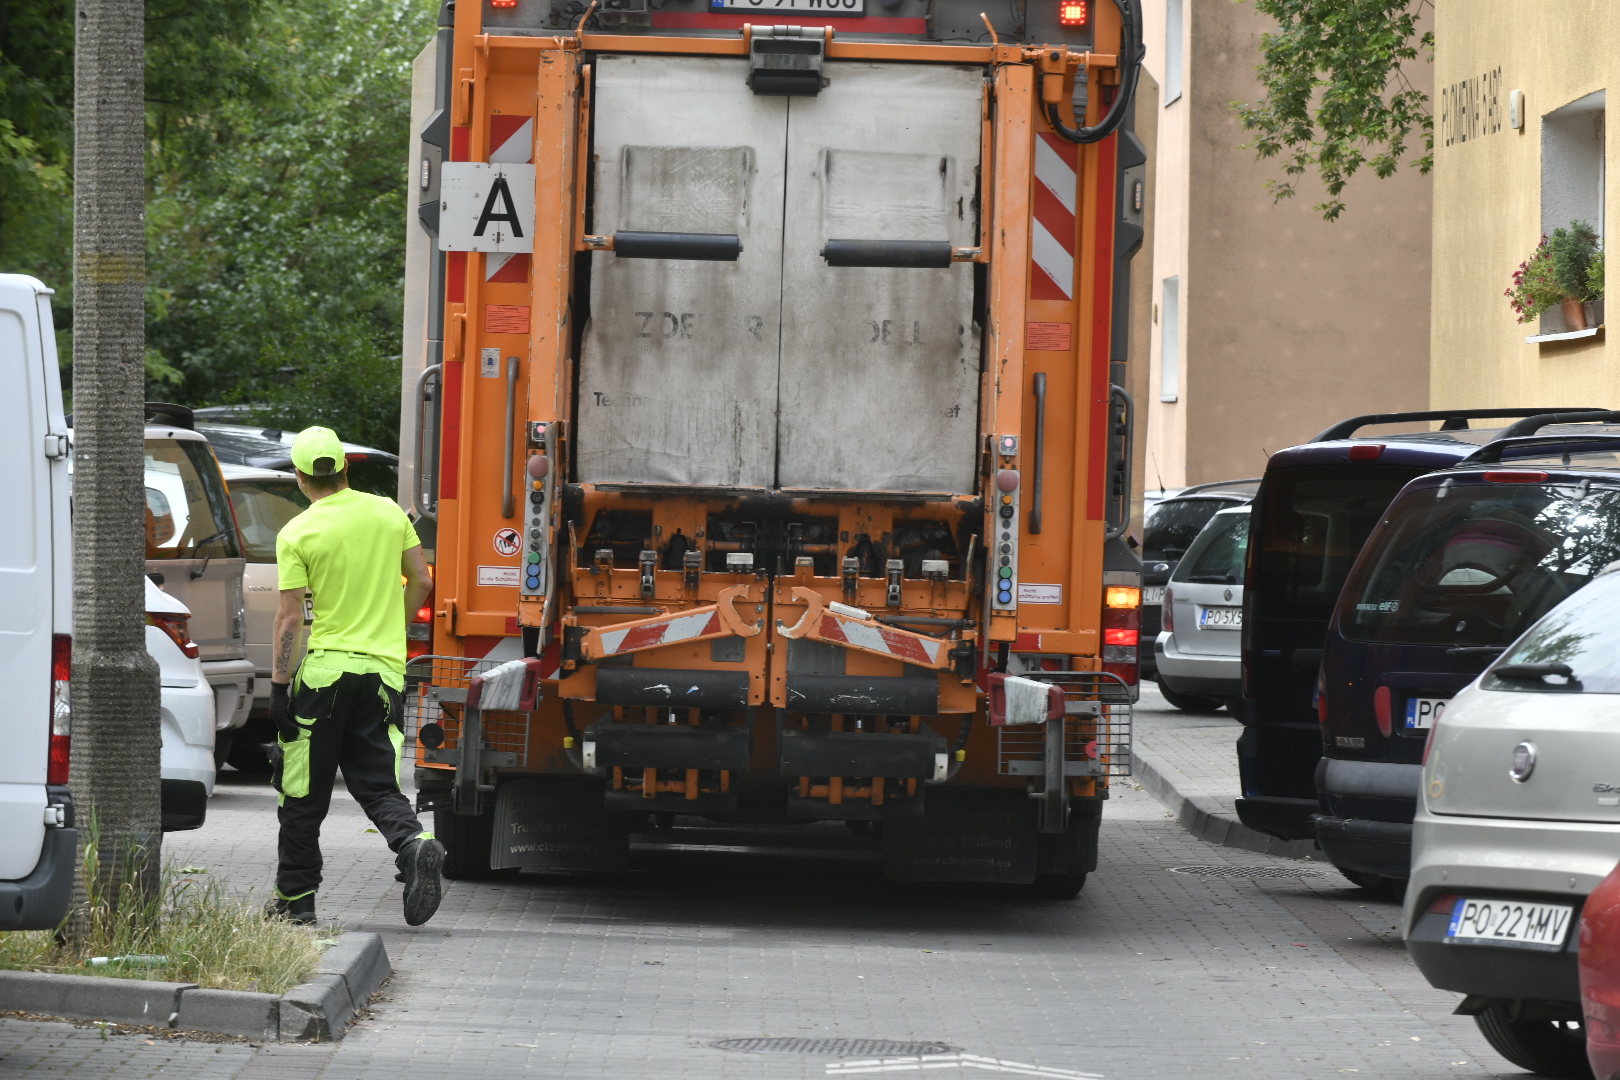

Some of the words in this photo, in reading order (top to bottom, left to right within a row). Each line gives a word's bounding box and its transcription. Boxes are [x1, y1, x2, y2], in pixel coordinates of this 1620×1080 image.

[473, 176, 525, 238] A
[1206, 610, 1221, 625] PO
[1459, 903, 1492, 935] PO
[1493, 905, 1568, 942] 221MV
